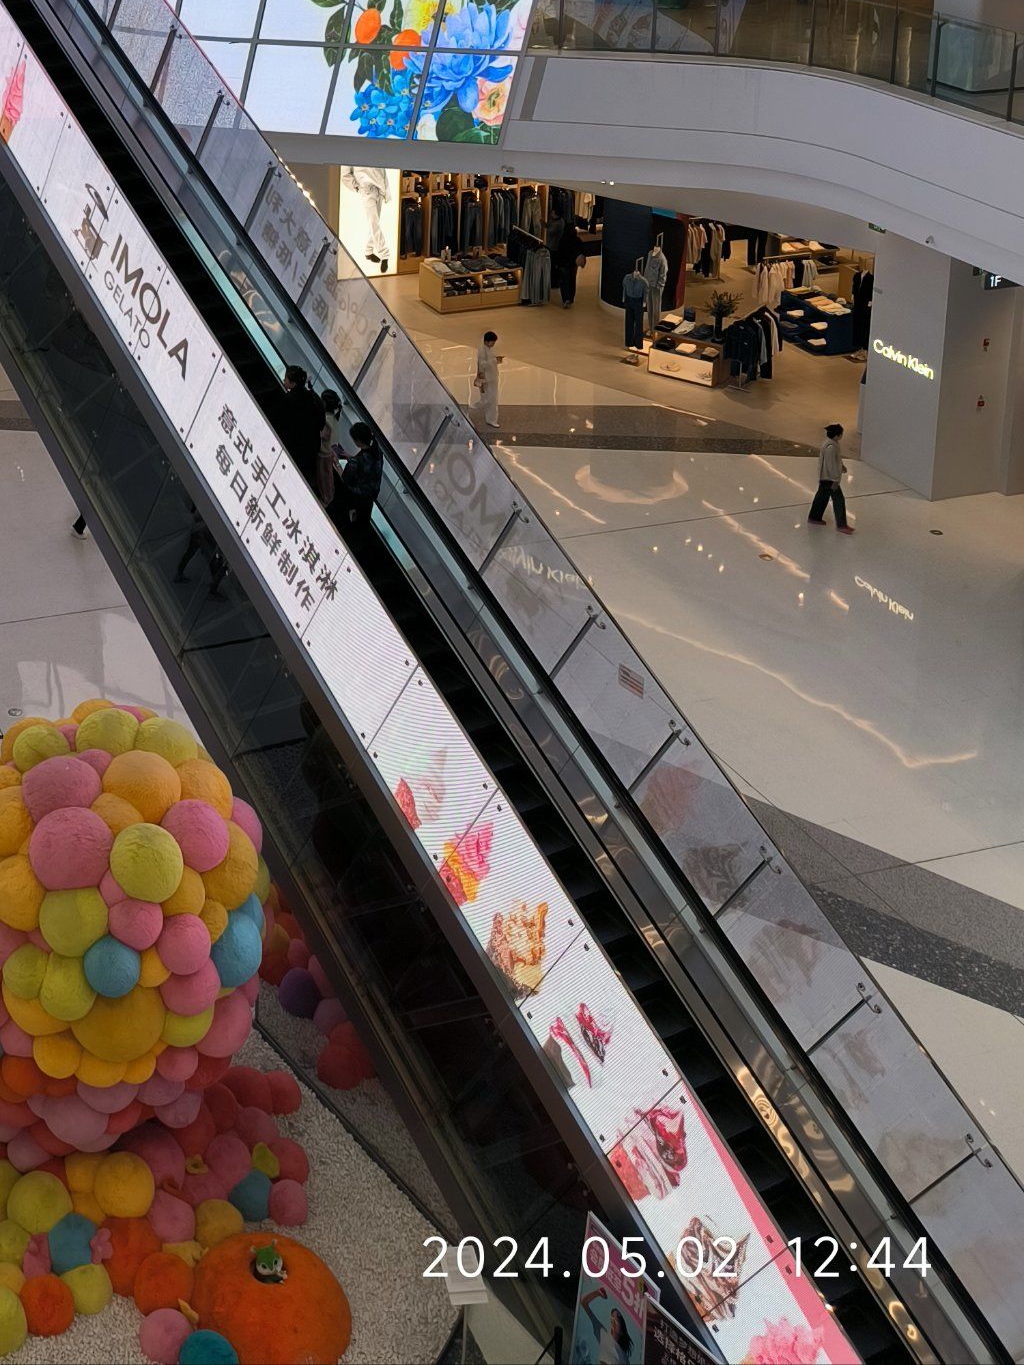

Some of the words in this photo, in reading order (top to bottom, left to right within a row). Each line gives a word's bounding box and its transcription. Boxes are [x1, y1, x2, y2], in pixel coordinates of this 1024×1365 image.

[103, 269, 150, 350] GELATO
[110, 233, 189, 382] IMOLA
[990, 275, 1002, 287] 1F
[873, 339, 907, 368] Calvin
[907, 354, 934, 381] Klein
[215, 444, 316, 613] 每日新鲜制作
[218, 403, 339, 602] 意式手工冰淇淋
